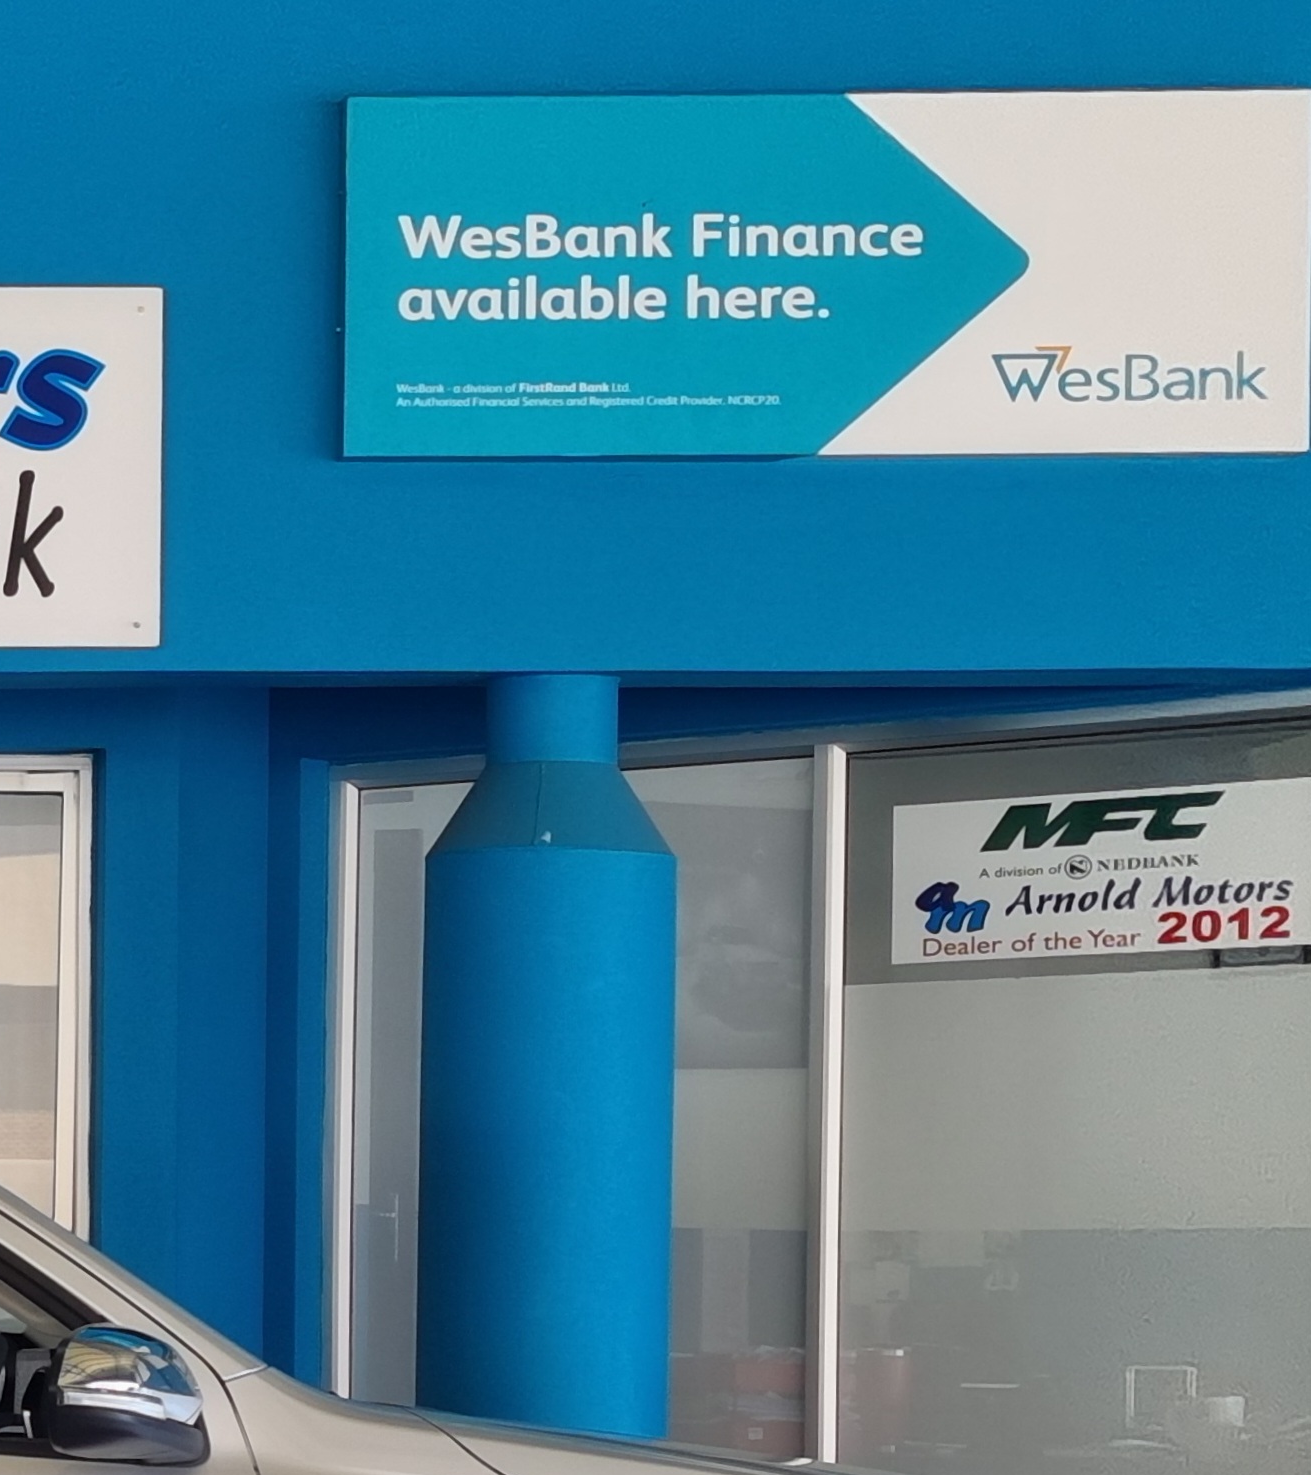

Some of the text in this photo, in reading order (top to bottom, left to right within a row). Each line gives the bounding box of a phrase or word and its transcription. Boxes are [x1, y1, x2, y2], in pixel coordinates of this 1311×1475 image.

[397, 213, 924, 259] WesBank Finance
[397, 275, 831, 321] available here.
[396, 384, 445, 394] WesBank
[453, 385, 461, 394] a
[462, 383, 503, 394] division
[505, 382, 517, 394] of
[519, 382, 577, 394] FirstRand
[579, 382, 610, 394] Bank
[612, 382, 631, 393] Ltd.
[991, 350, 1269, 402] WesBank
[396, 397, 411, 408] An
[413, 396, 471, 408] Authorised
[472, 396, 520, 407] Financial
[522, 396, 564, 407] Services
[566, 396, 588, 407] and
[589, 396, 645, 409] Registered
[646, 395, 678, 406] Credit
[979, 790, 1226, 852] MFC
[979, 863, 1063, 880] A division of
[1096, 853, 1201, 873] NEDBANK
[1005, 876, 1295, 918] Arnold Motors
[923, 905, 1292, 958] Dealer of the Year 2012
